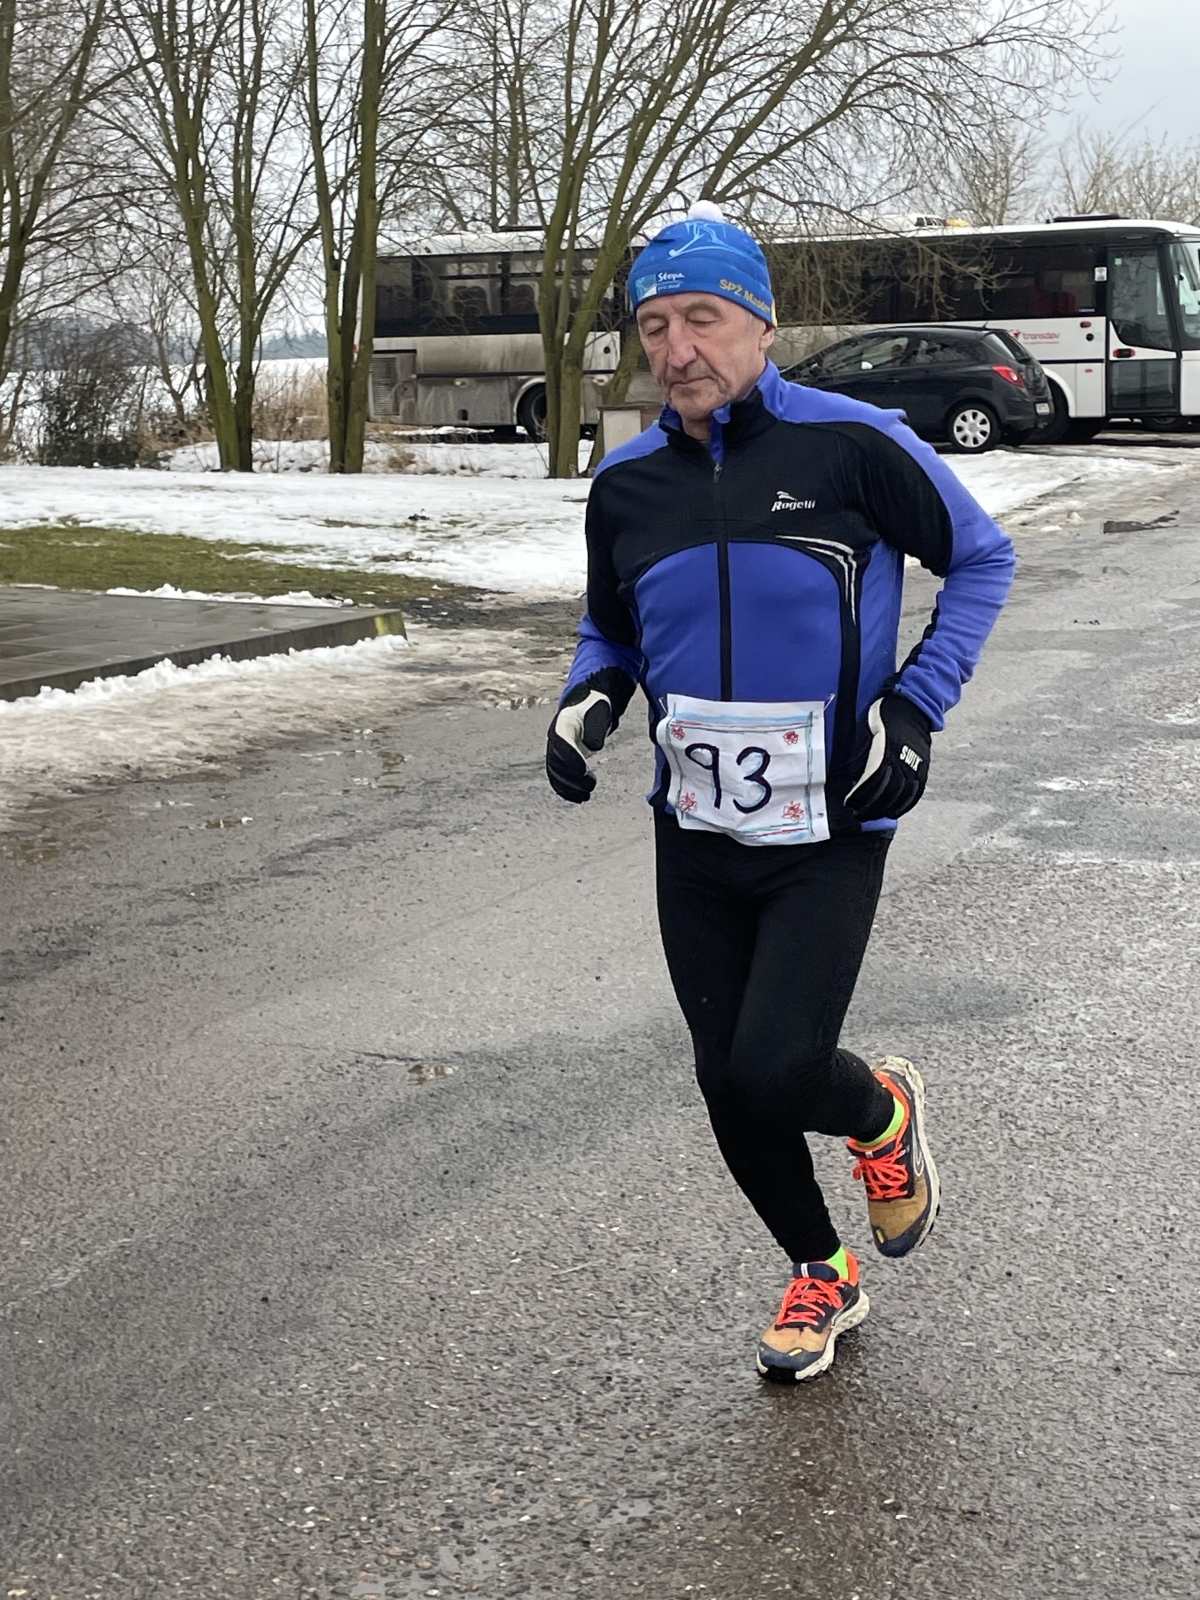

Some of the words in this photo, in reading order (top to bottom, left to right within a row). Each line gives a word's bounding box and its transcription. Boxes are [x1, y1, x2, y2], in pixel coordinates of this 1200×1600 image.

[1022, 332, 1060, 340] transdev
[771, 500, 816, 512] Rogelli
[685, 743, 772, 814] 93
